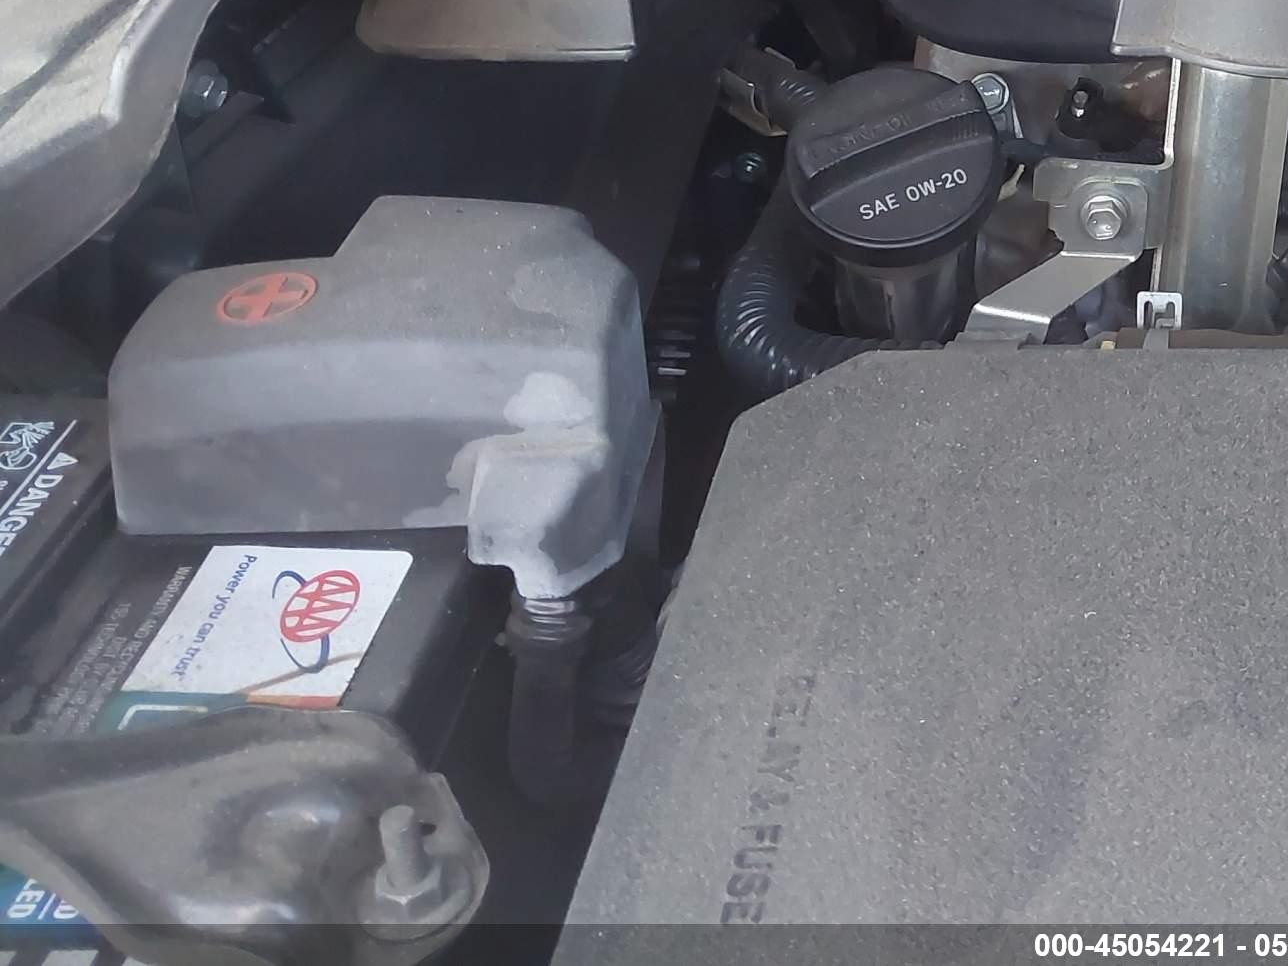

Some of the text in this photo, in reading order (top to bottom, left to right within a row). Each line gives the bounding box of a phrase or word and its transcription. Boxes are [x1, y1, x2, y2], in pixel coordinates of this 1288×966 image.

[859, 168, 967, 220] SAE 0W-20
[0, 474, 64, 557] DANGE
[225, 554, 257, 593] Power
[193, 622, 214, 643] can
[208, 594, 231, 619] you
[281, 572, 360, 641] AAA
[719, 824, 782, 924] FUSE
